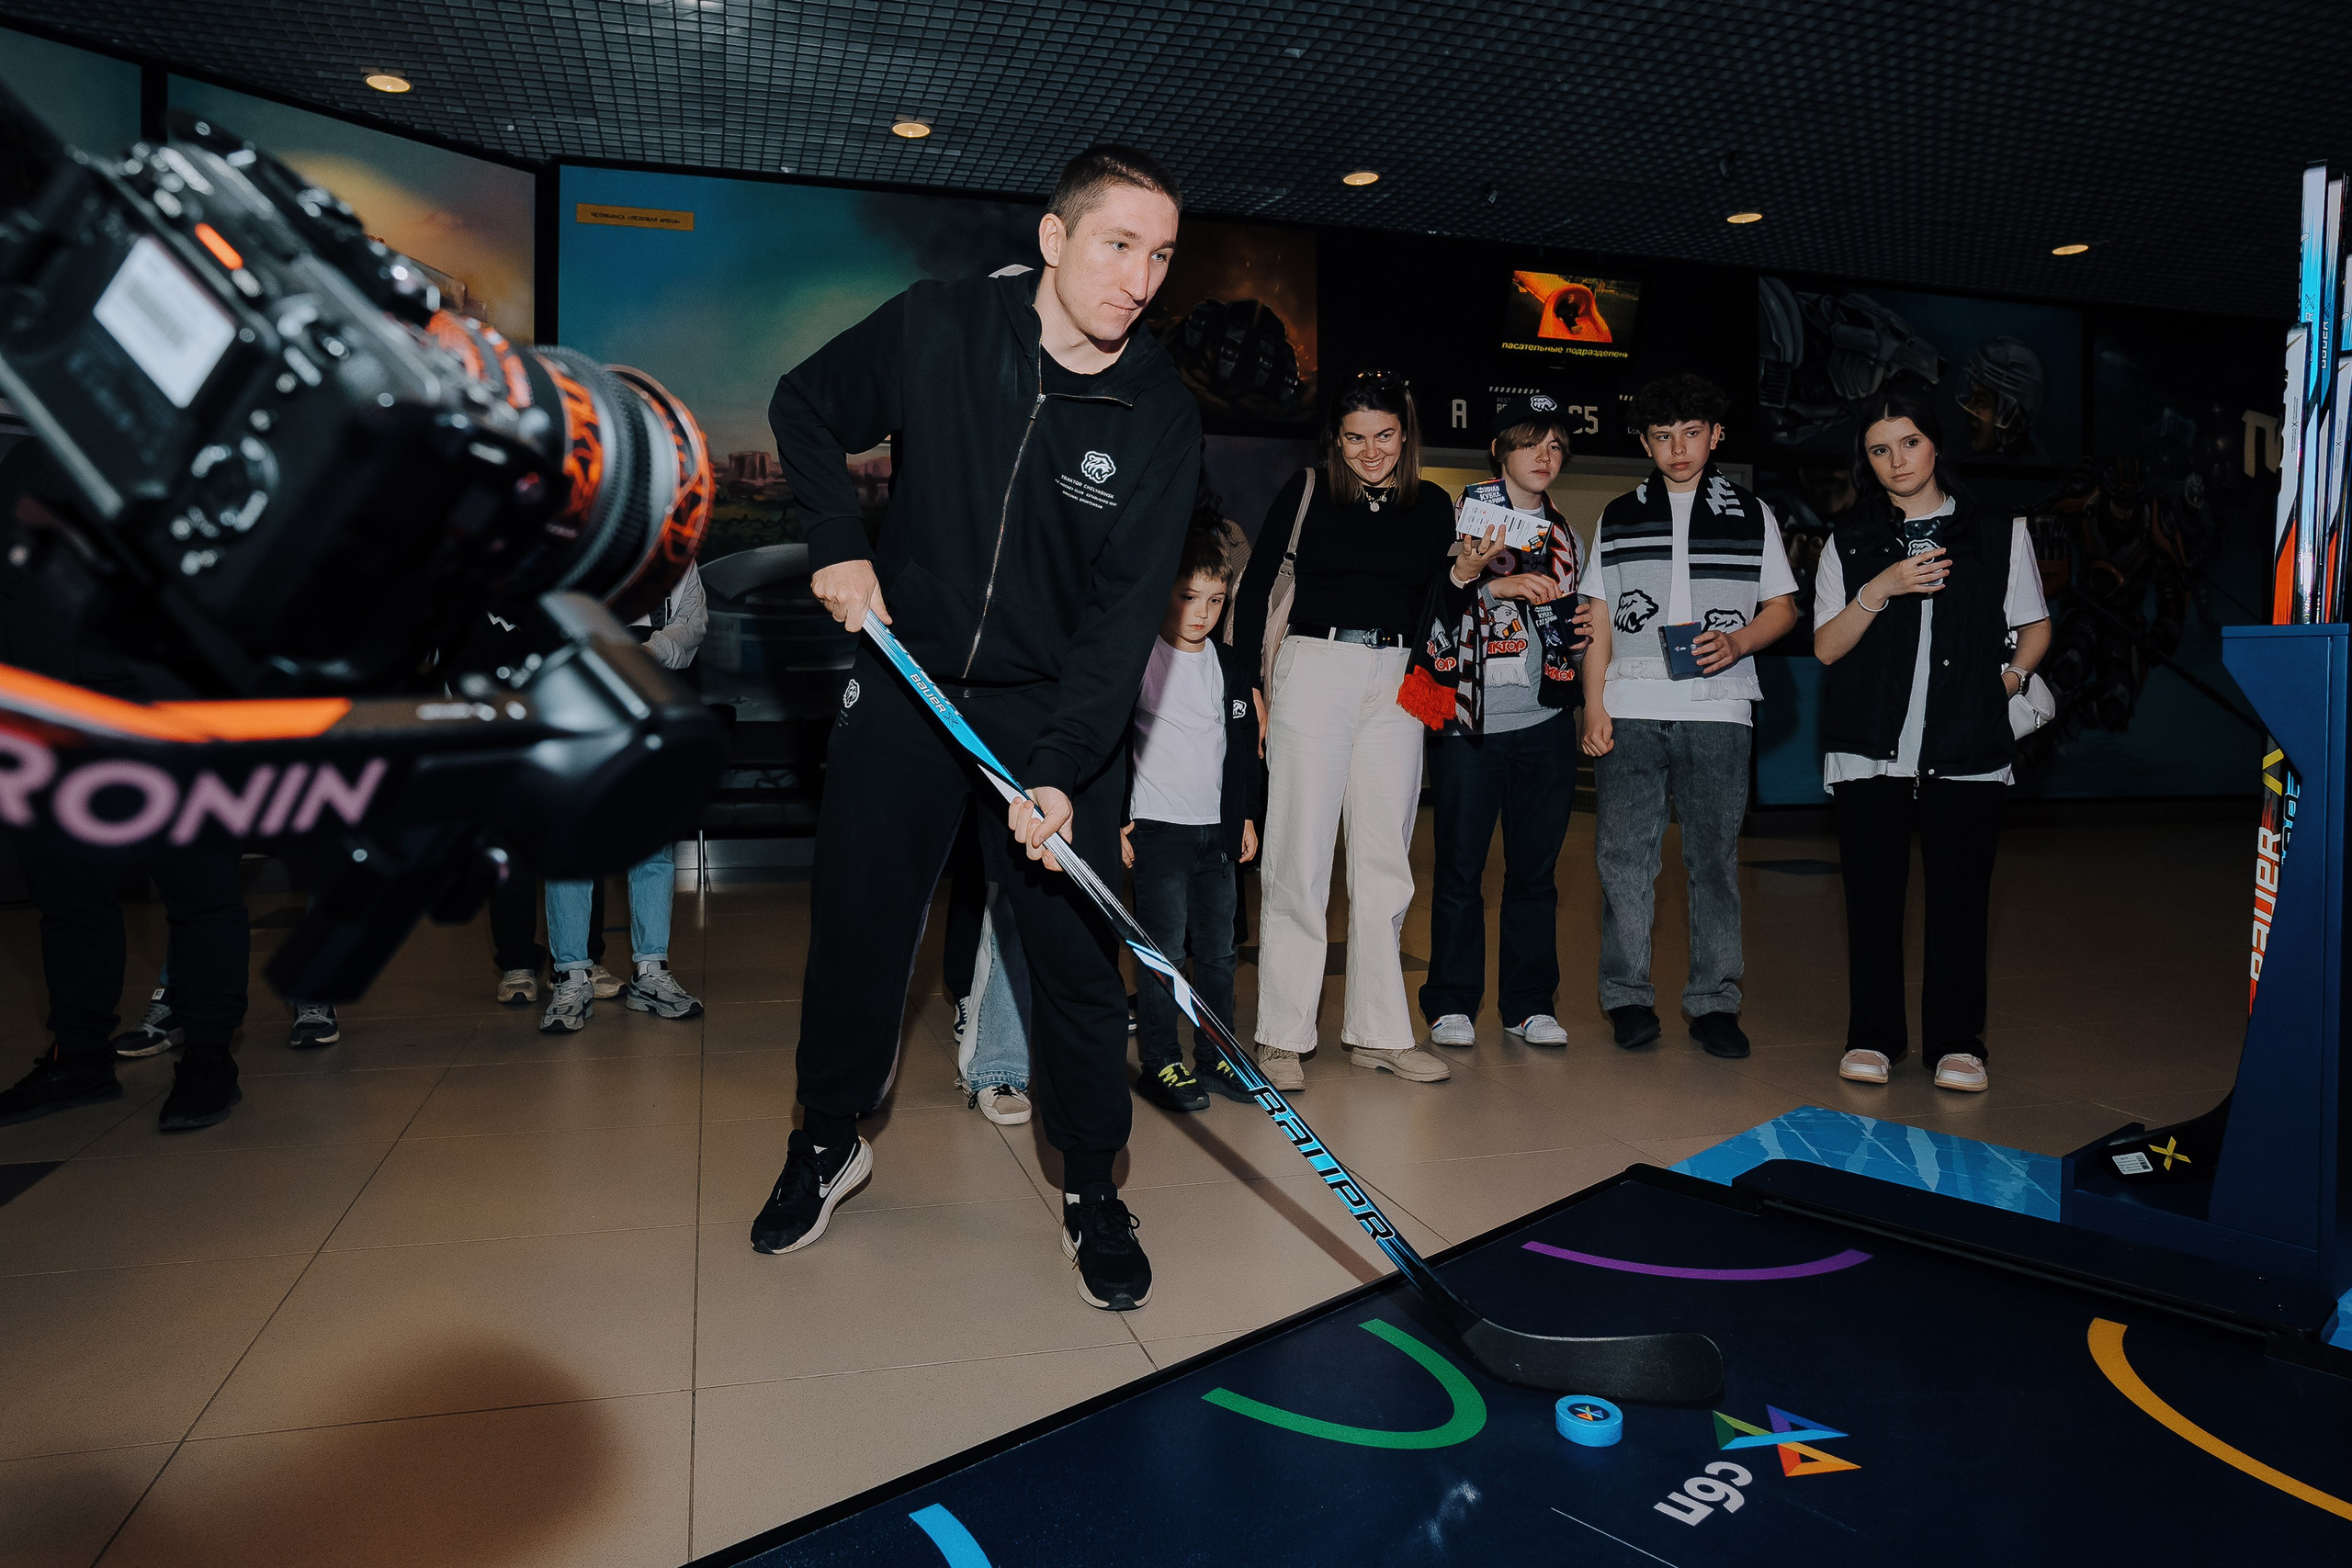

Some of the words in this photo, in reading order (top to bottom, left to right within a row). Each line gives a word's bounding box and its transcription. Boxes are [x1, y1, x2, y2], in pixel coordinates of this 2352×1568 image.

[1501, 341, 1564, 354] пасательные
[1061, 474, 1082, 488] TRAKTOR
[1083, 484, 1114, 500] CHELYABINSK
[910, 673, 947, 714] BAUER
[0, 734, 390, 847] RONIN
[1249, 1085, 1396, 1242] BAUER
